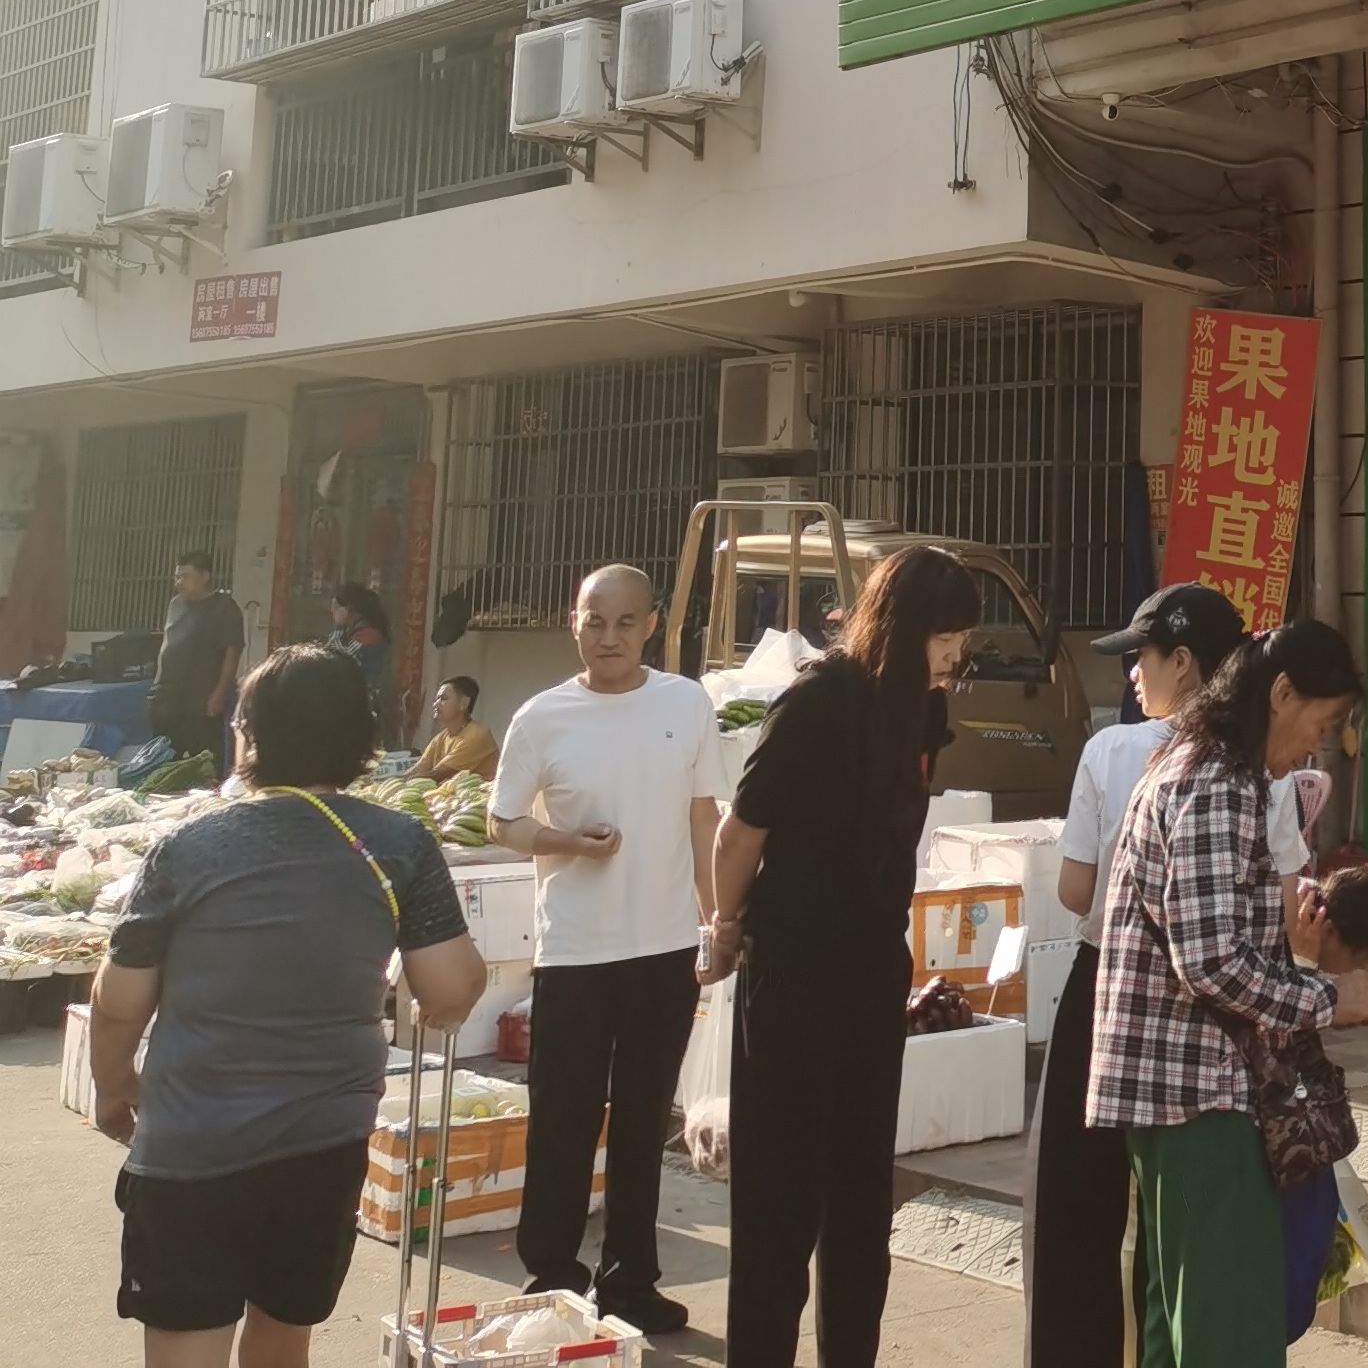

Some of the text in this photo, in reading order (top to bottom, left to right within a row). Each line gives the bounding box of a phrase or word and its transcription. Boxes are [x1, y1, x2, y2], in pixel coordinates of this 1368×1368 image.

[1177, 315, 1217, 507] 欢迎果地观光
